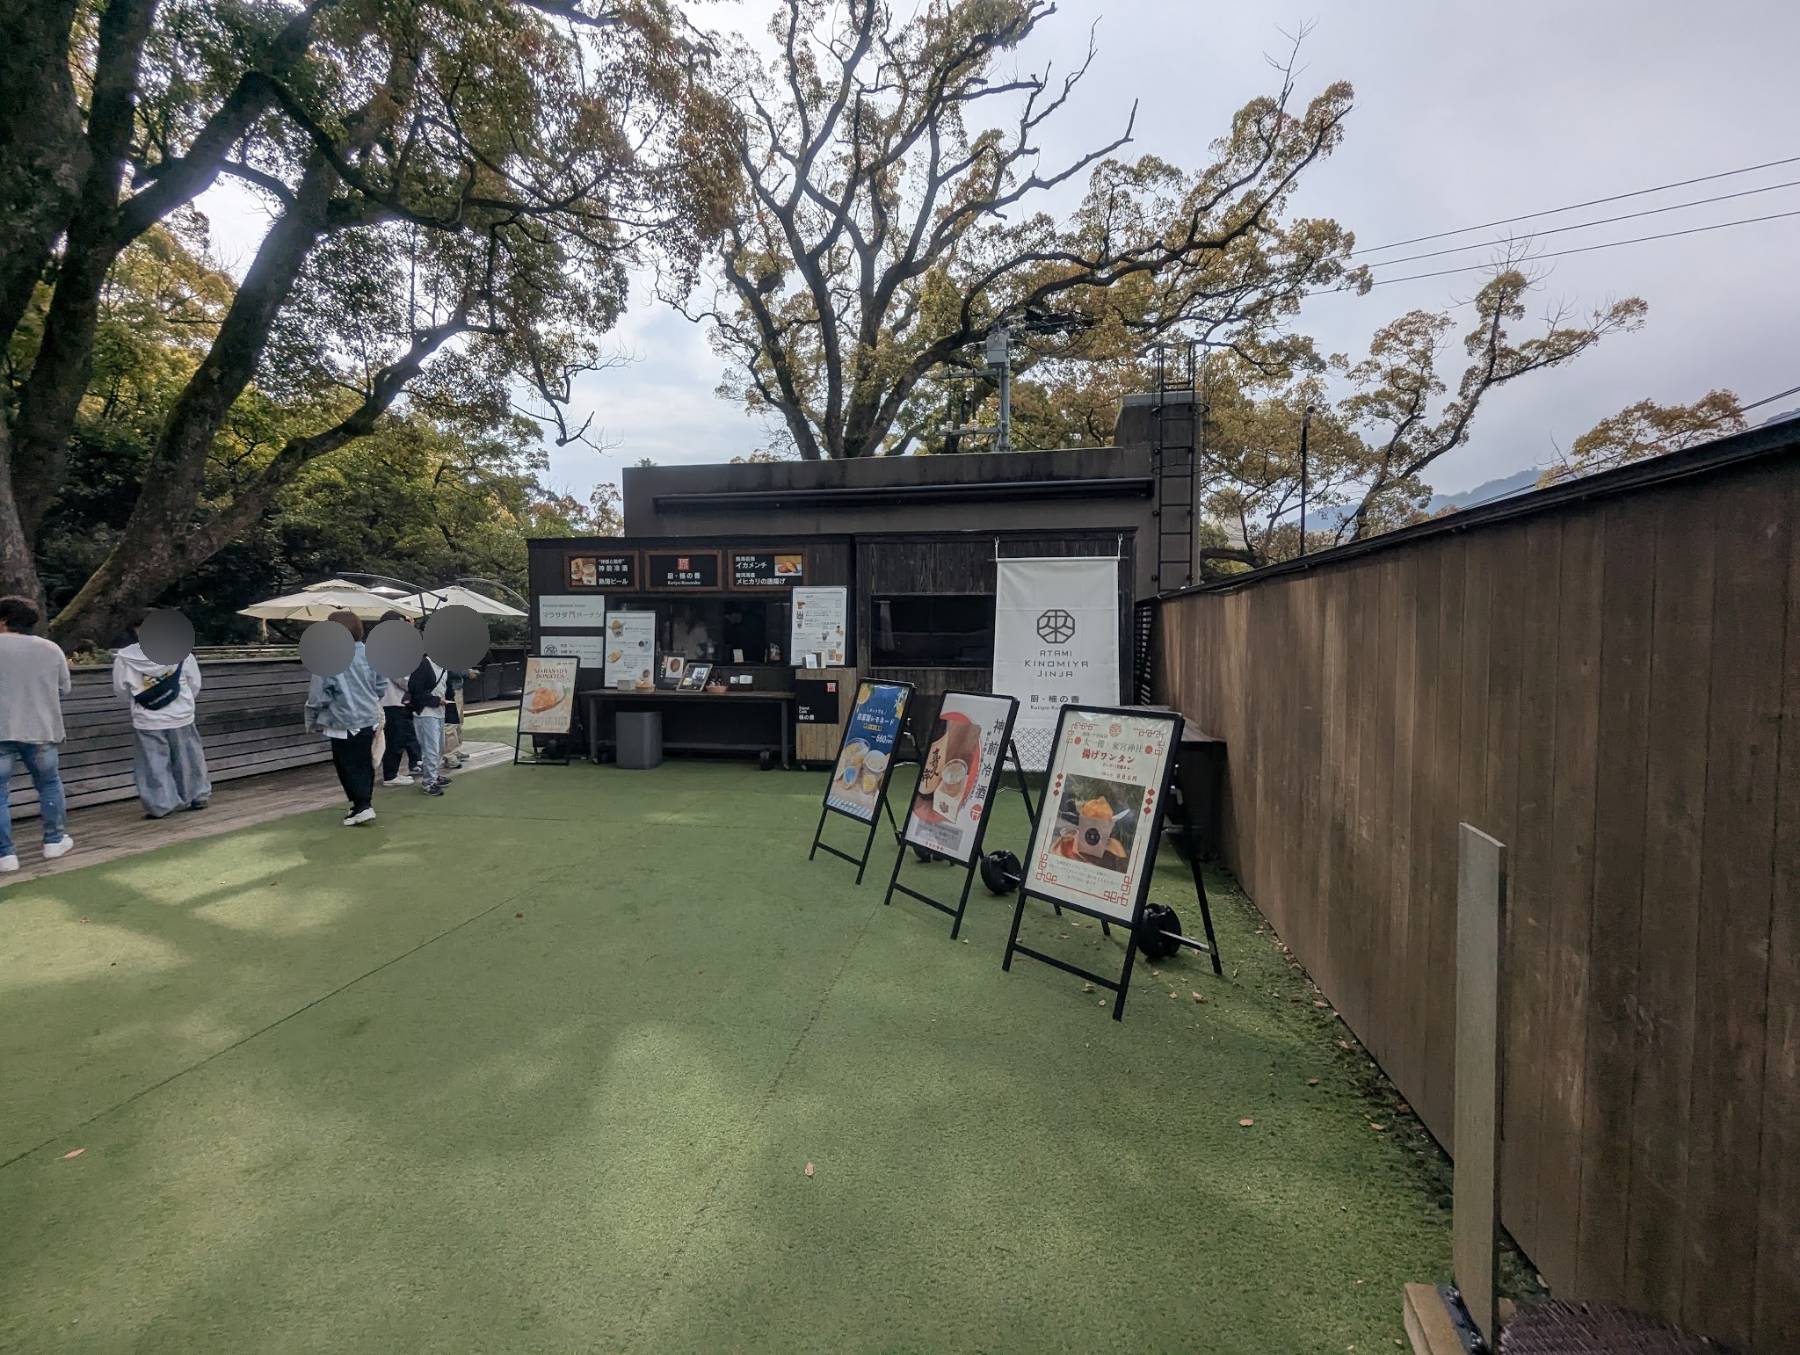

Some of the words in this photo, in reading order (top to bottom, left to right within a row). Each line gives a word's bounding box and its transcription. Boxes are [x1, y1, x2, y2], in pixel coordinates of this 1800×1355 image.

[1082, 748, 1135, 763] 揚げワンタン
